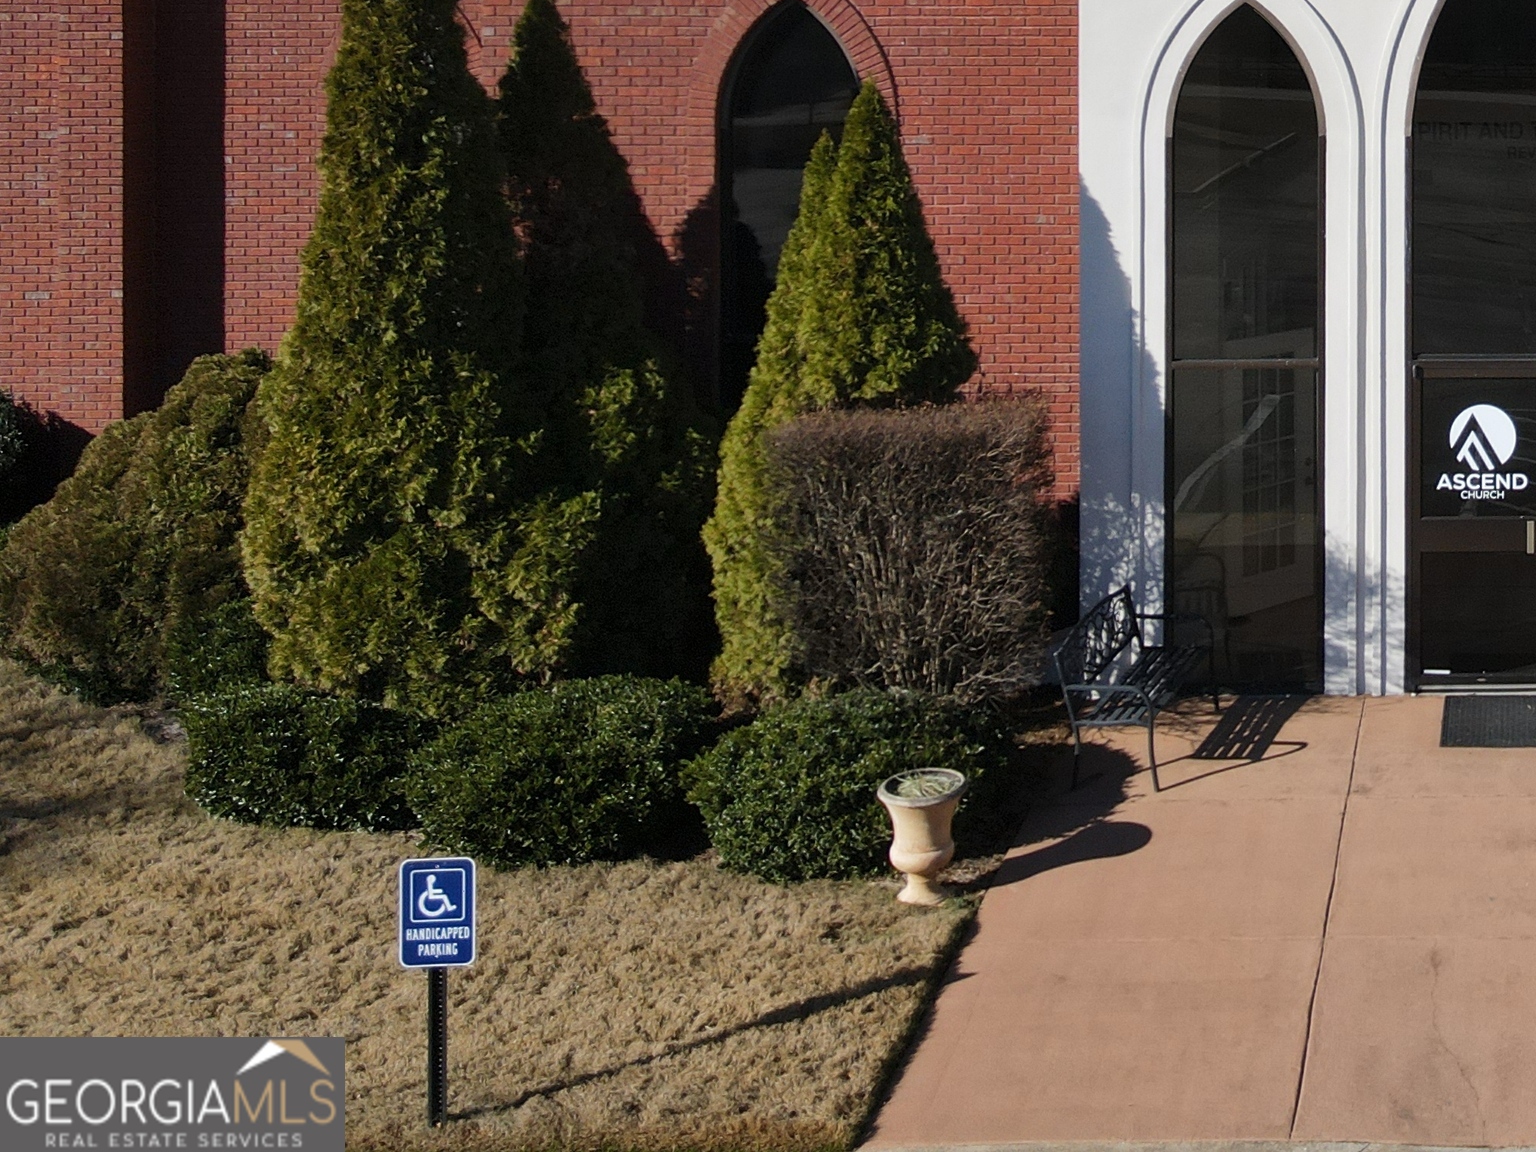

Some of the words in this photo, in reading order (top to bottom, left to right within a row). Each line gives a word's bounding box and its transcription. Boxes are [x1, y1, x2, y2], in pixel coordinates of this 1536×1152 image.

[1416, 121, 1473, 140] PIRIT
[1479, 121, 1524, 140] AND
[1436, 473, 1529, 490] ASCEND
[1460, 490, 1505, 499] CHURCH
[405, 926, 470, 941] HANDICAPPED
[417, 942, 458, 957] PARKING
